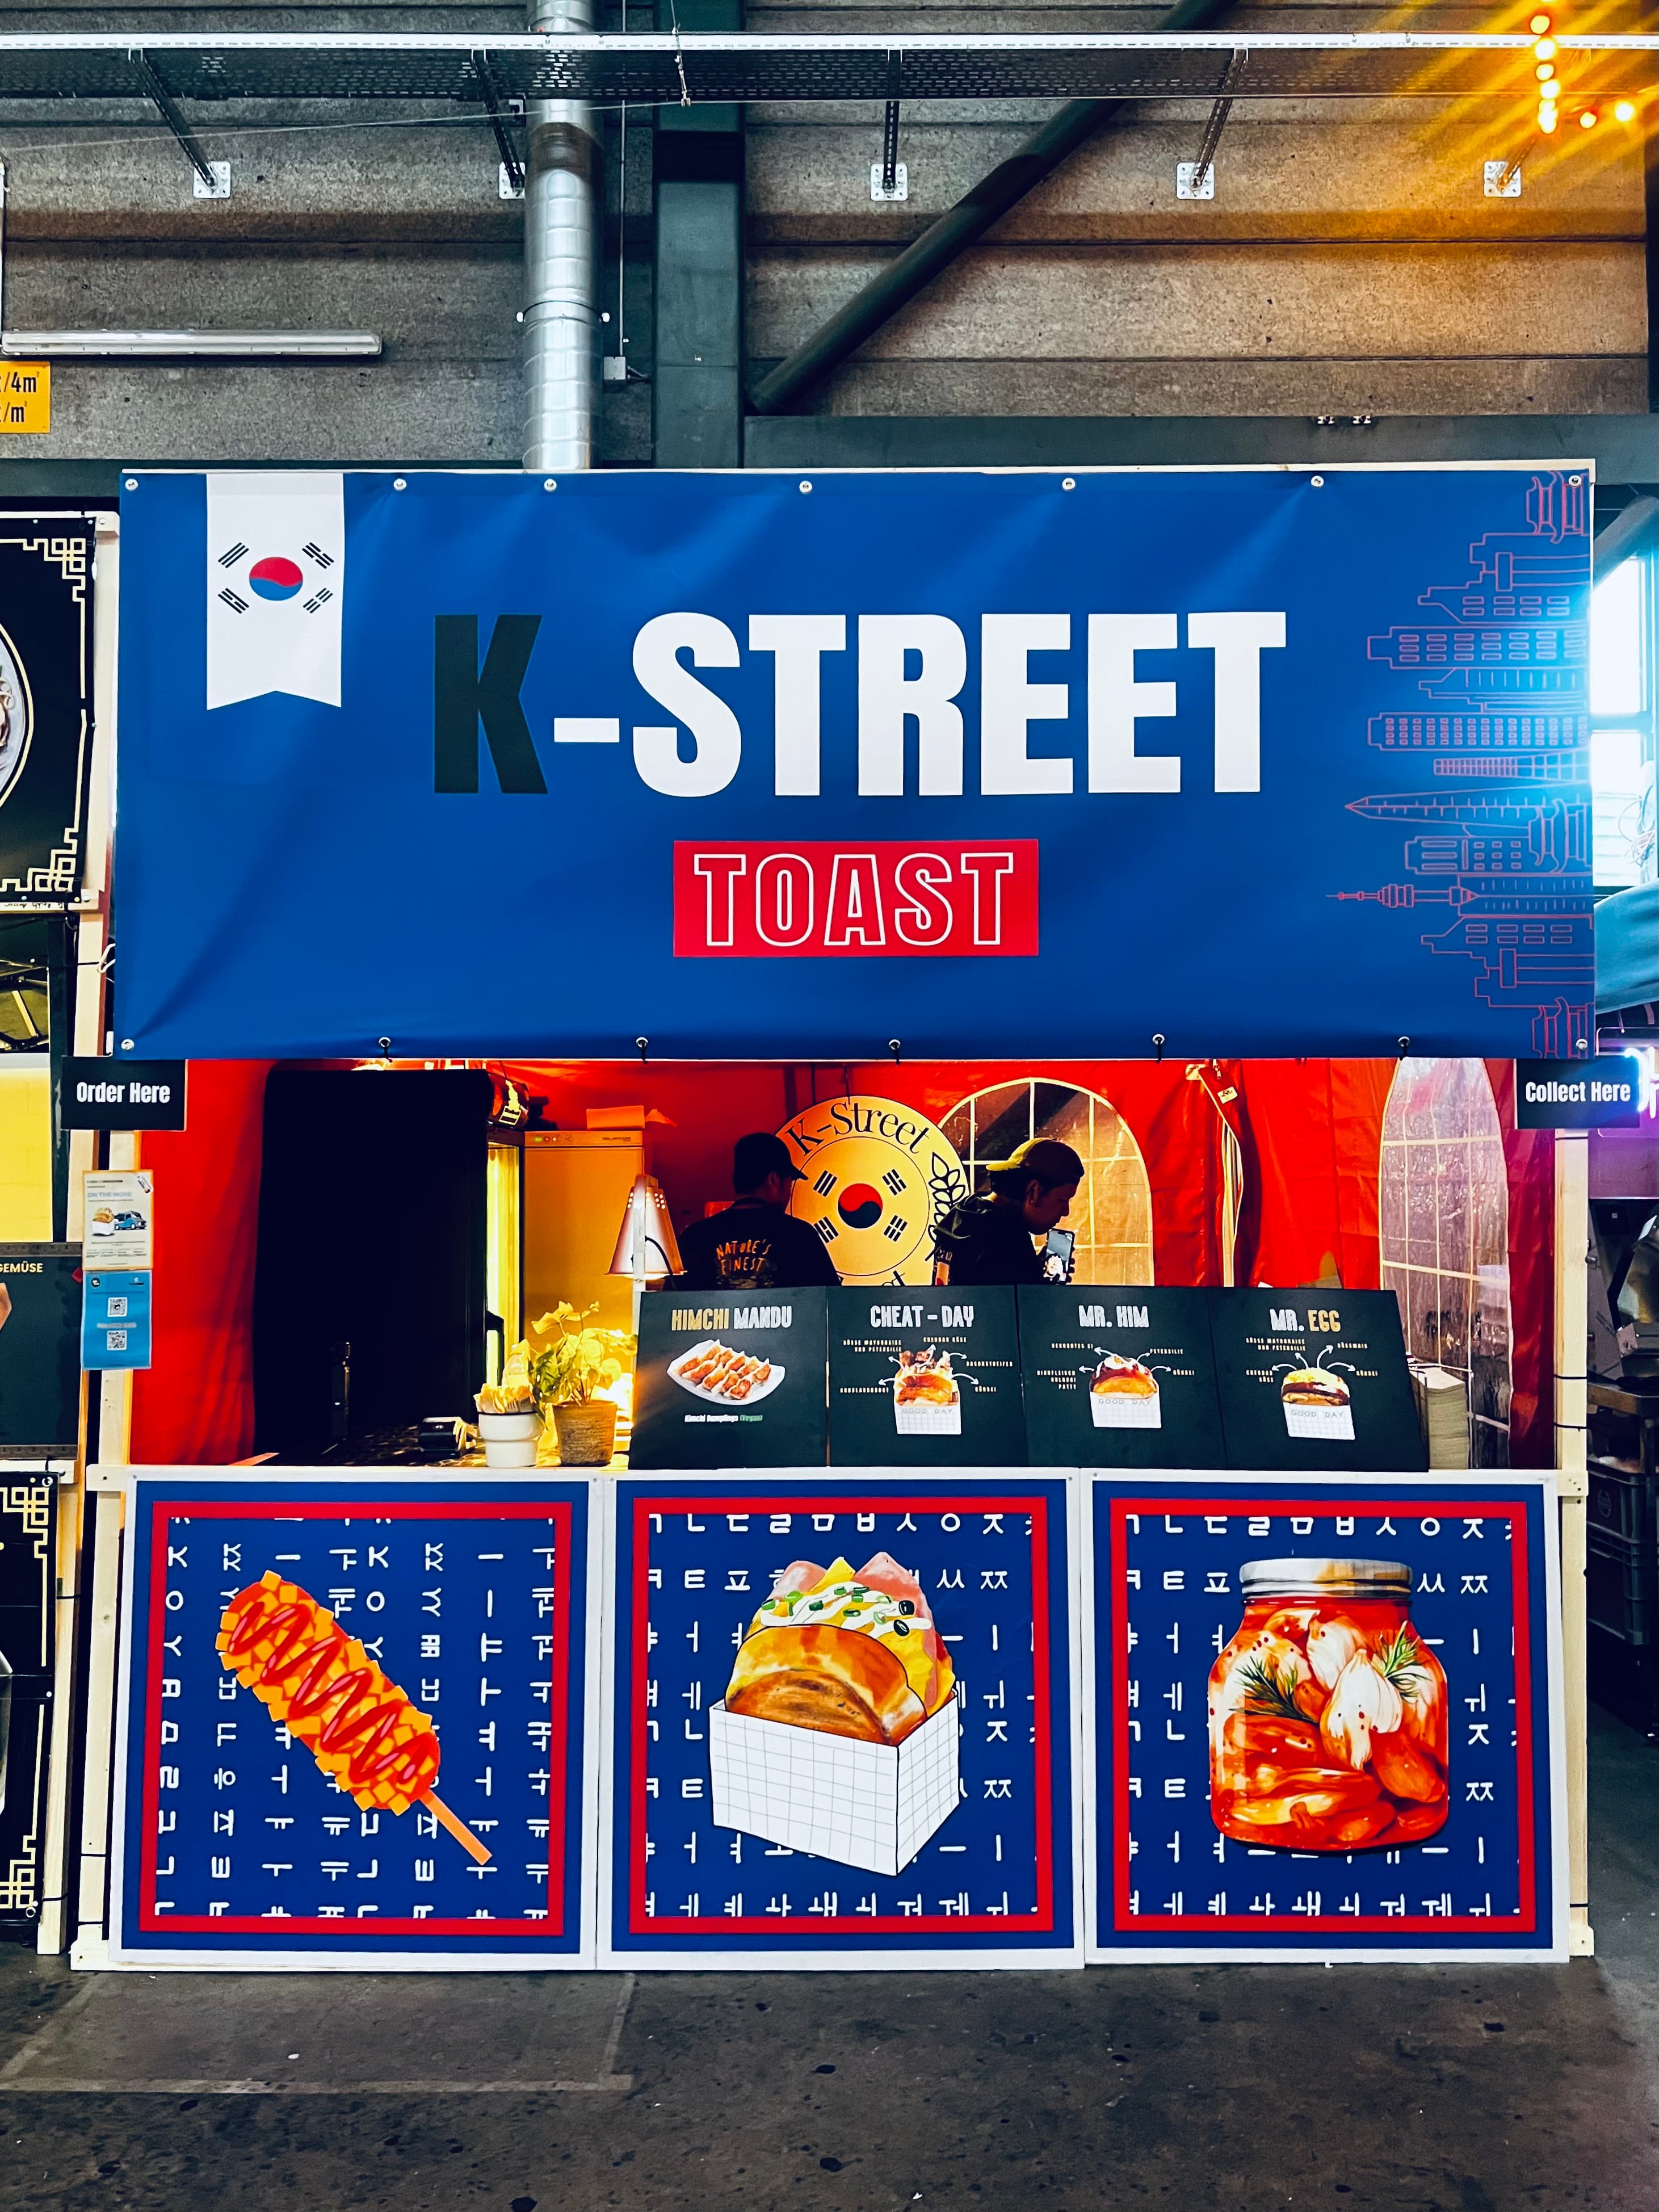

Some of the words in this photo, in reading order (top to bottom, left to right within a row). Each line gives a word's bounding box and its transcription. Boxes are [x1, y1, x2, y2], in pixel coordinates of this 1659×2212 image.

[434, 611, 1287, 798] K-STREET
[694, 852, 1014, 947] TOAST
[77, 1082, 125, 1102] Order
[129, 1082, 170, 1103] Here
[1526, 1081, 1586, 1102] Collect
[1591, 1081, 1631, 1102] Here
[785, 1102, 930, 1156] K-Street
[734, 1306, 792, 1329] MANDU
[870, 1306, 923, 1328] CHEAT
[942, 1306, 974, 1328] DAY
[1078, 1306, 1112, 1328] MR.
[1270, 1309, 1304, 1331] MR.
[1308, 1310, 1341, 1332] EGG
